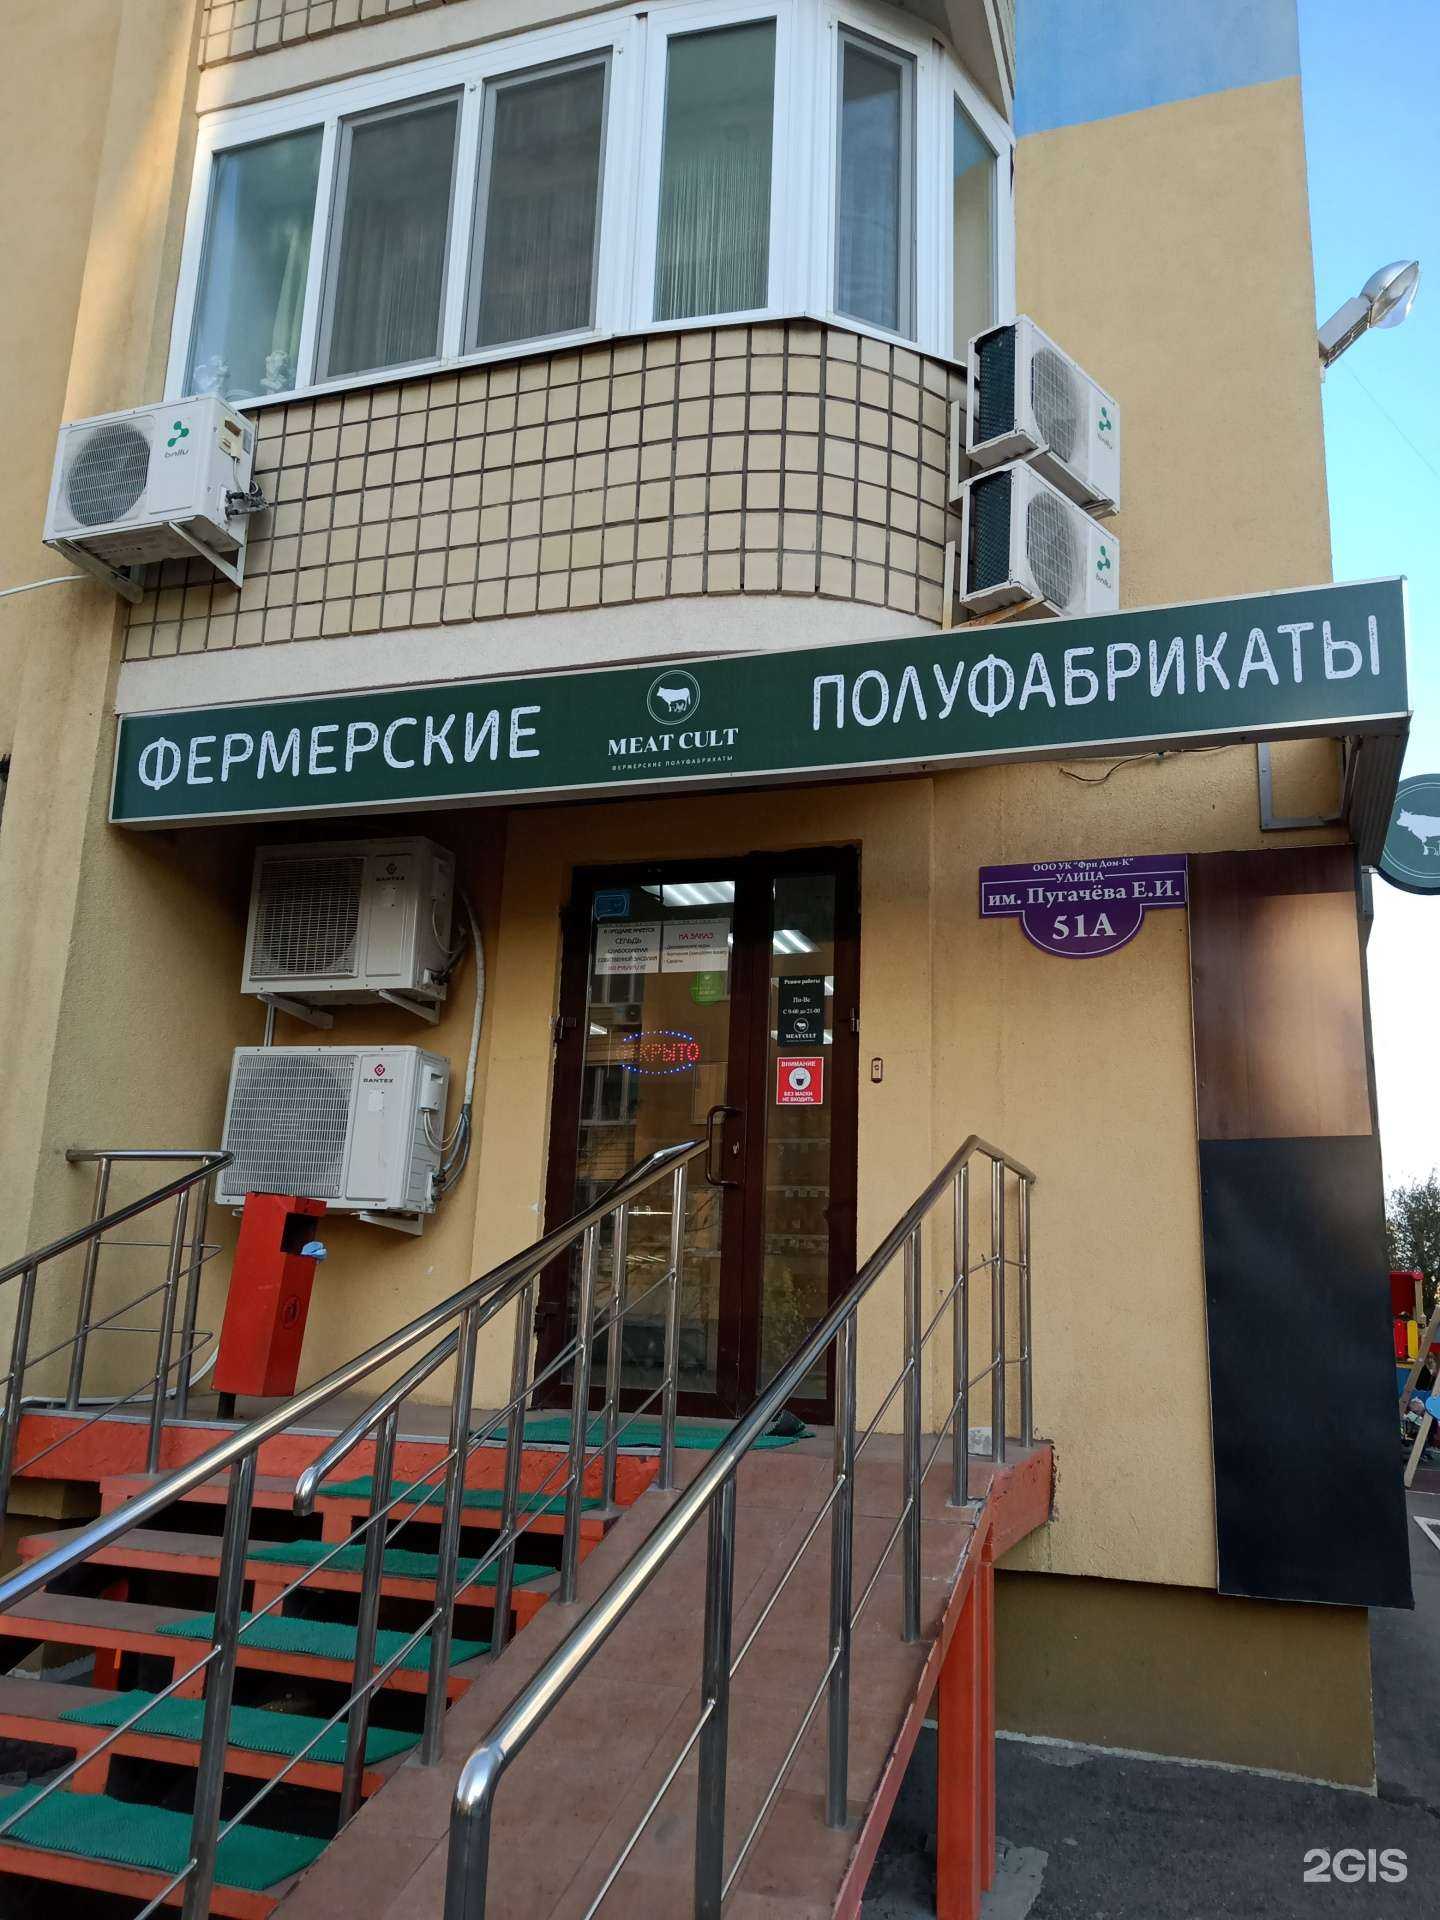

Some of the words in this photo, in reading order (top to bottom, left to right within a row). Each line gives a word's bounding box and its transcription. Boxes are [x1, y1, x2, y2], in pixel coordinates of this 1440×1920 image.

[138, 705, 541, 790] ФЕРМЕРСКИЕ
[812, 615, 1381, 731] ПОЛУФАБРИКАТЫ
[608, 734, 674, 756] MEAT
[678, 728, 739, 749] CULT
[611, 761, 662, 771] ФЕРМЕРСКИЕ
[665, 755, 733, 767] ПОЛУФАБРИКАТЫ
[1033, 863, 1057, 872] ООО
[1057, 862, 1073, 871] УК
[1056, 871, 1105, 884] УЛИЦА
[988, 893, 1021, 906] им.
[1026, 884, 1127, 908] Пугачёва
[1131, 879, 1181, 898] Е.И.
[1052, 912, 1117, 940] 51А
